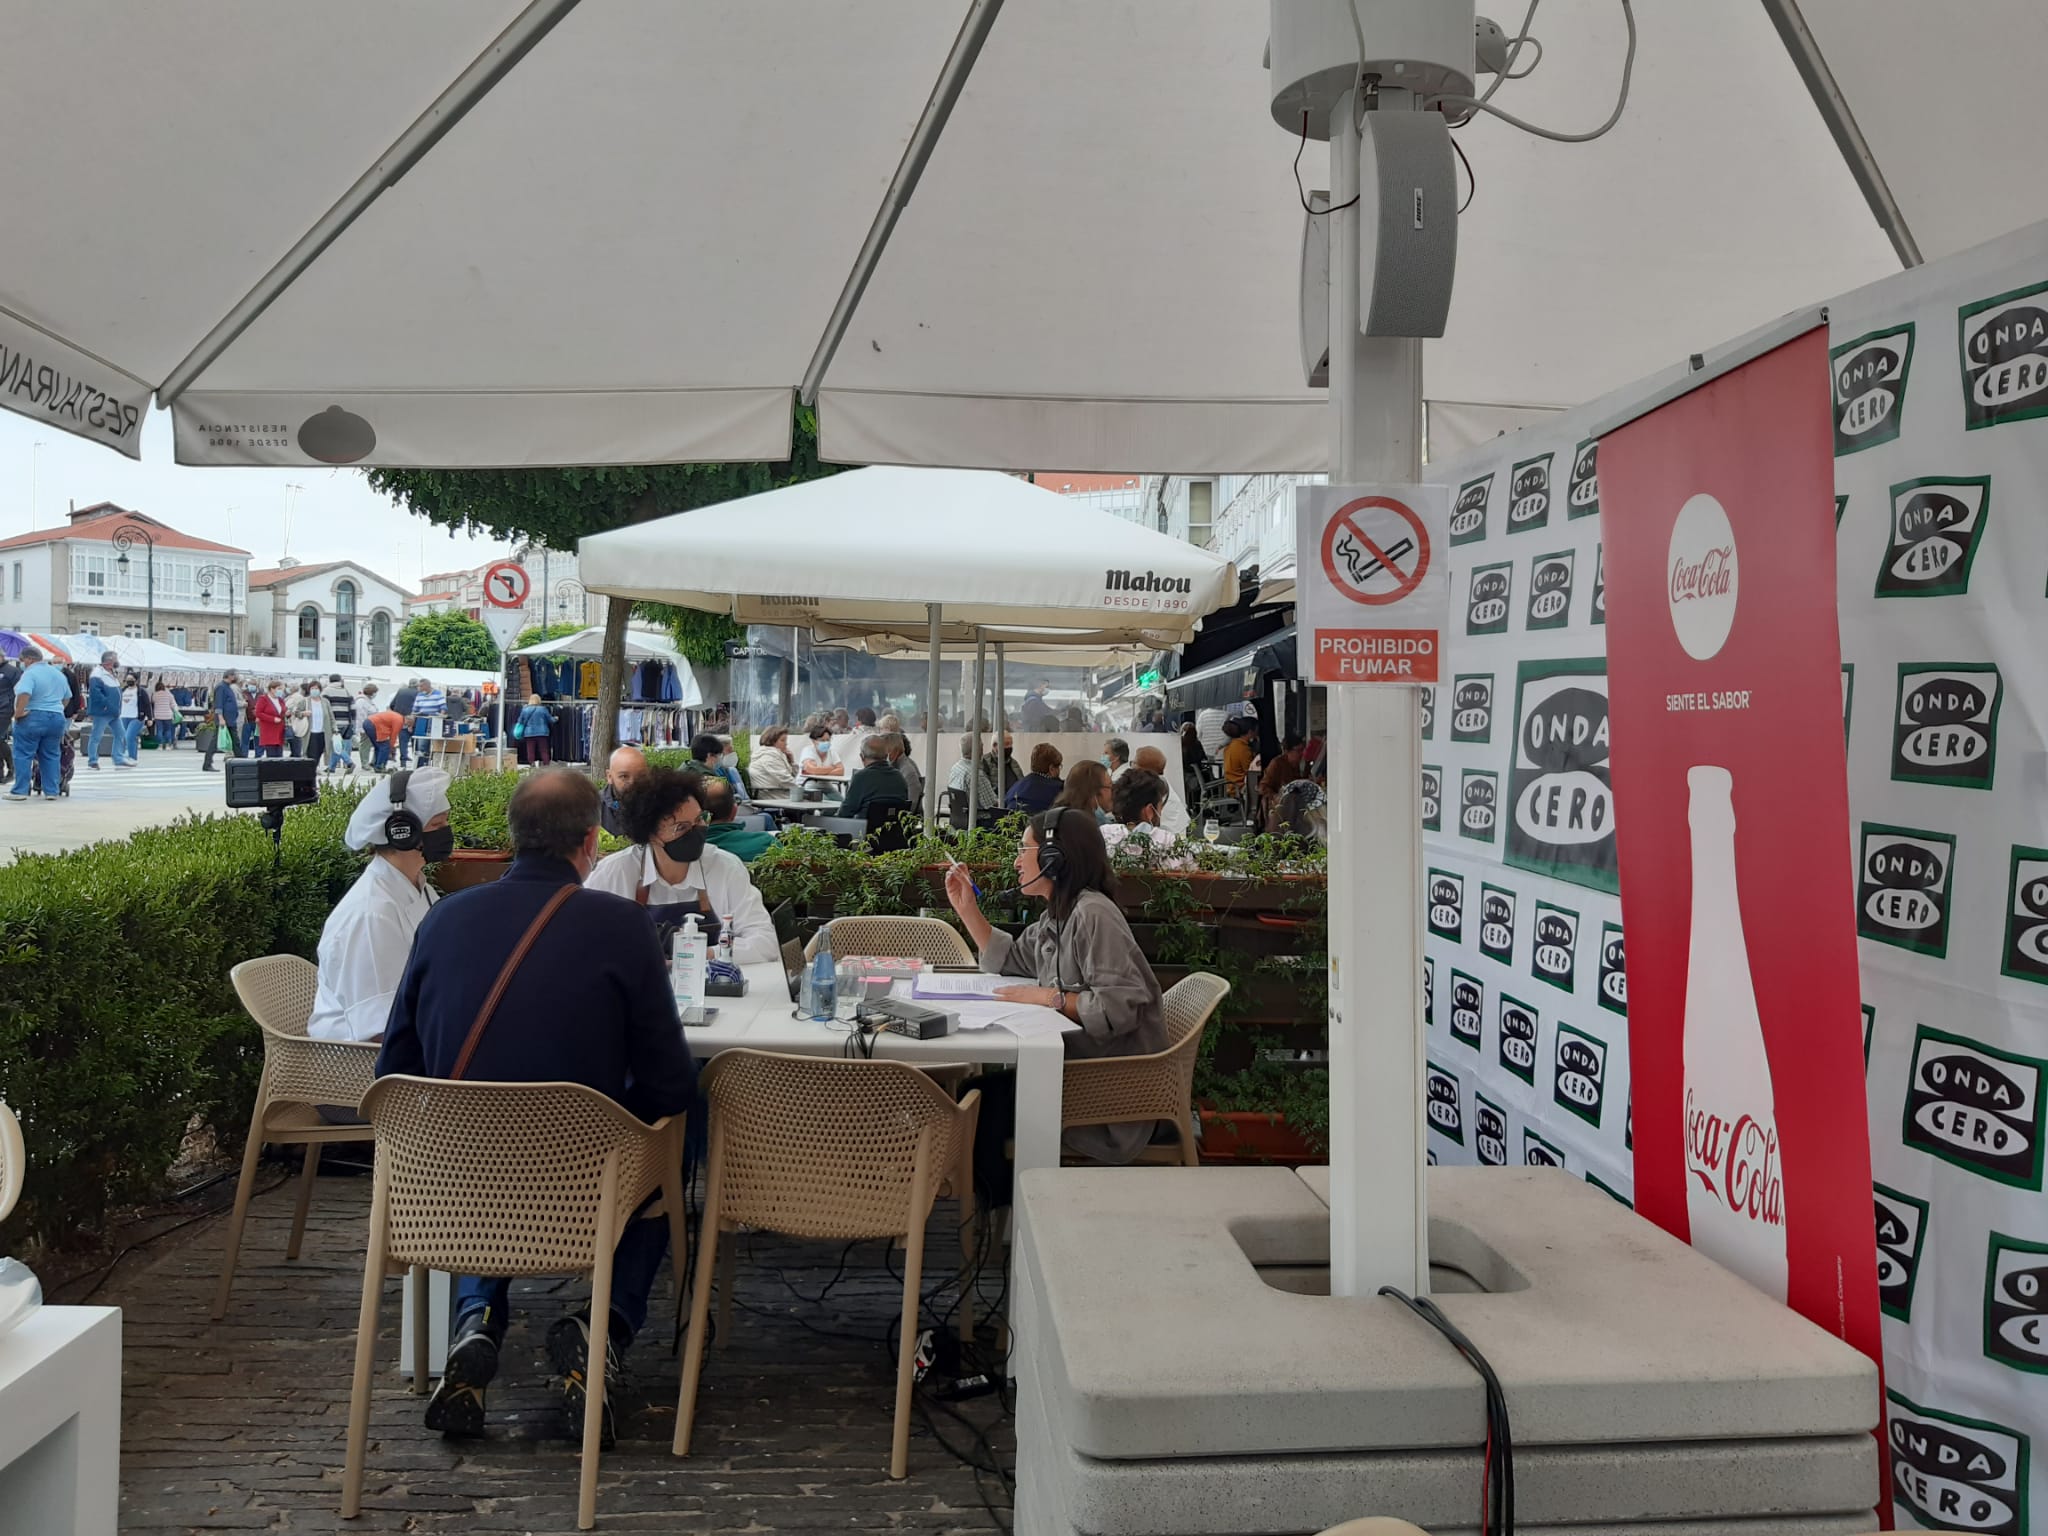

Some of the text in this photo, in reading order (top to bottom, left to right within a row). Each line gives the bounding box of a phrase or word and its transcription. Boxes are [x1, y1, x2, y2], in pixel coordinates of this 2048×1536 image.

[1976, 316, 2045, 355] ONDA
[1841, 356, 1889, 390] ONDA
[1982, 361, 2048, 399] CERO
[1848, 394, 1886, 429] CERO
[1516, 472, 1545, 490] ONDA
[1458, 490, 1483, 509] ONDA
[1515, 497, 1544, 520] CERO
[1454, 512, 1480, 532] CERO
[1903, 503, 1954, 532] ONDA
[1905, 544, 1950, 574] CERO
[1106, 569, 1191, 594] Mahou
[1537, 570, 1566, 585] ONDA
[1671, 545, 1733, 604] Coca-Cola
[1475, 578, 1505, 595] ONDA
[1103, 596, 1188, 609] DESDE 1890
[1474, 604, 1504, 620] CERO
[1535, 594, 1562, 613] CERO
[1319, 638, 1433, 655] PROHIBIDO
[1340, 658, 1412, 675] FUMAR
[1458, 691, 1487, 702] ONDA
[1666, 690, 1750, 711] SIENTE EL SABOR
[1912, 692, 1976, 714] ONDA
[1458, 713, 1486, 728] CERO
[1530, 712, 1609, 749] ONDA
[1911, 732, 1976, 758] CERO
[1467, 784, 1493, 800] ONDA
[1466, 808, 1491, 825] CERO
[1529, 784, 1606, 833] CERO
[1875, 854, 1936, 882] ONDA
[1434, 885, 1457, 901] ONDA
[1434, 907, 1456, 925] CERO
[1485, 901, 1509, 920] ONDA
[1876, 893, 1930, 924] CERO
[1484, 928, 1507, 945] CERO
[1539, 921, 1570, 942] ONDA
[1539, 949, 1568, 971] CERO
[1505, 1013, 1532, 1036] ONDA
[1505, 1040, 1530, 1062] CERO
[1562, 1045, 1597, 1072] ONDA
[1429, 1078, 1456, 1101] ONDA
[1563, 1075, 1594, 1101] CERO
[1932, 1062, 2012, 1106] ONDA
[1430, 1103, 1457, 1124] CERO
[1930, 1105, 2009, 1151] CERO
[1685, 1088, 1784, 1226] Coca-Cola
[1892, 1421, 1992, 1477] ONDA
[1902, 1465, 1992, 1523] CERO
